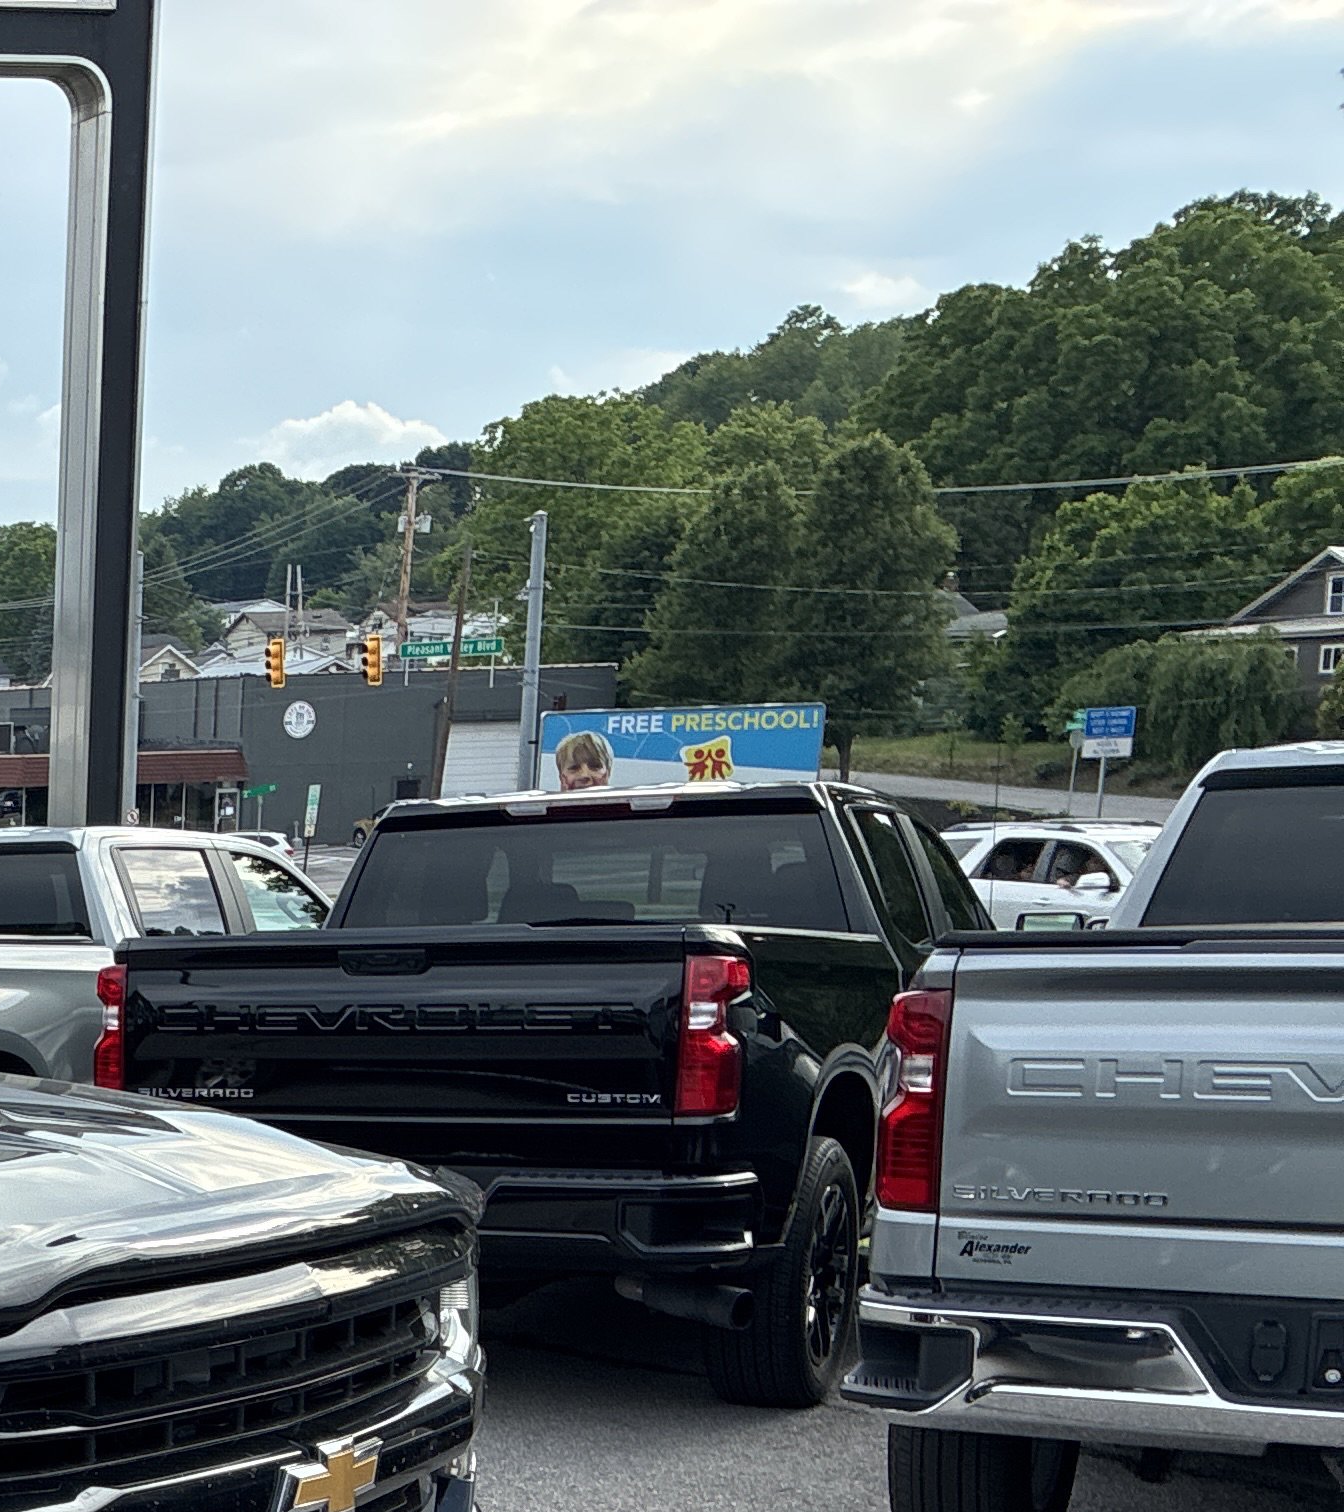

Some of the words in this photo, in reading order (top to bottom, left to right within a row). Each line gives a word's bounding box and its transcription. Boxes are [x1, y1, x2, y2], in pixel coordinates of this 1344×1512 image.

[407, 645, 443, 655] Pleasant
[477, 641, 496, 652] Blvd
[608, 714, 663, 734] FREE
[671, 709, 819, 732] PRESCHOOL!
[157, 1002, 635, 1031] CHEVROLET
[138, 1087, 254, 1099] SILVERADO
[568, 1093, 661, 1105] CUSTOM
[952, 1184, 1169, 1207] SILVERADO
[960, 1240, 1031, 1256] Alexander
